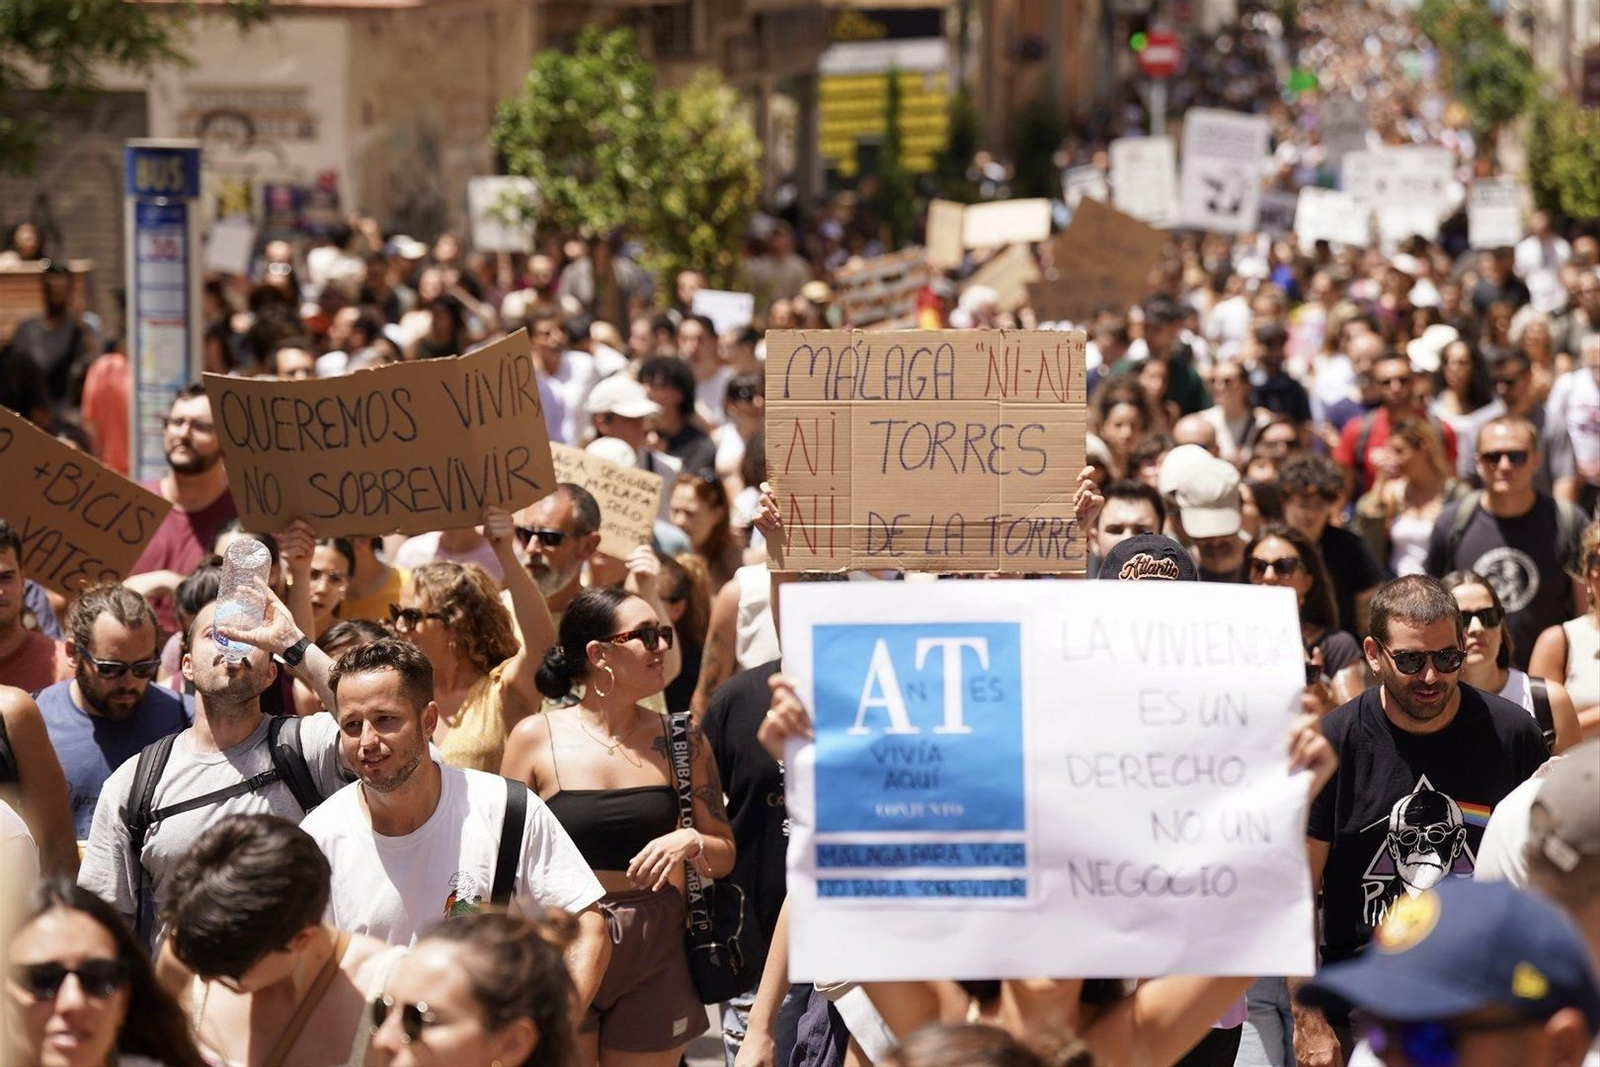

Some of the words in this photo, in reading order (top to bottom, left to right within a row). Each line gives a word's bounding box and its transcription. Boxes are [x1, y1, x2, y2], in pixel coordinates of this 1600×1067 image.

[783, 340, 955, 401] MÁLAGA
[221, 388, 418, 454] QUEREMOS
[869, 418, 1047, 477] TORRES
[244, 465, 282, 517] NO
[308, 446, 541, 519] SOBREVIVIR
[786, 487, 836, 559] NI
[867, 511, 912, 558] DE
[925, 513, 965, 556] LA
[984, 514, 1084, 560] TORRE
[1061, 616, 1116, 662] LA
[1130, 620, 1297, 668] VIVIENDA
[1138, 687, 1188, 726] ES
[1199, 691, 1249, 728] UN
[673, 741, 692, 790] BIMBA
[1151, 810, 1204, 844] NO
[1221, 811, 1272, 845] UN
[685, 864, 704, 903] IMBA
[1067, 859, 1239, 898] NEGOCIO
[1361, 881, 1399, 927] PIN
